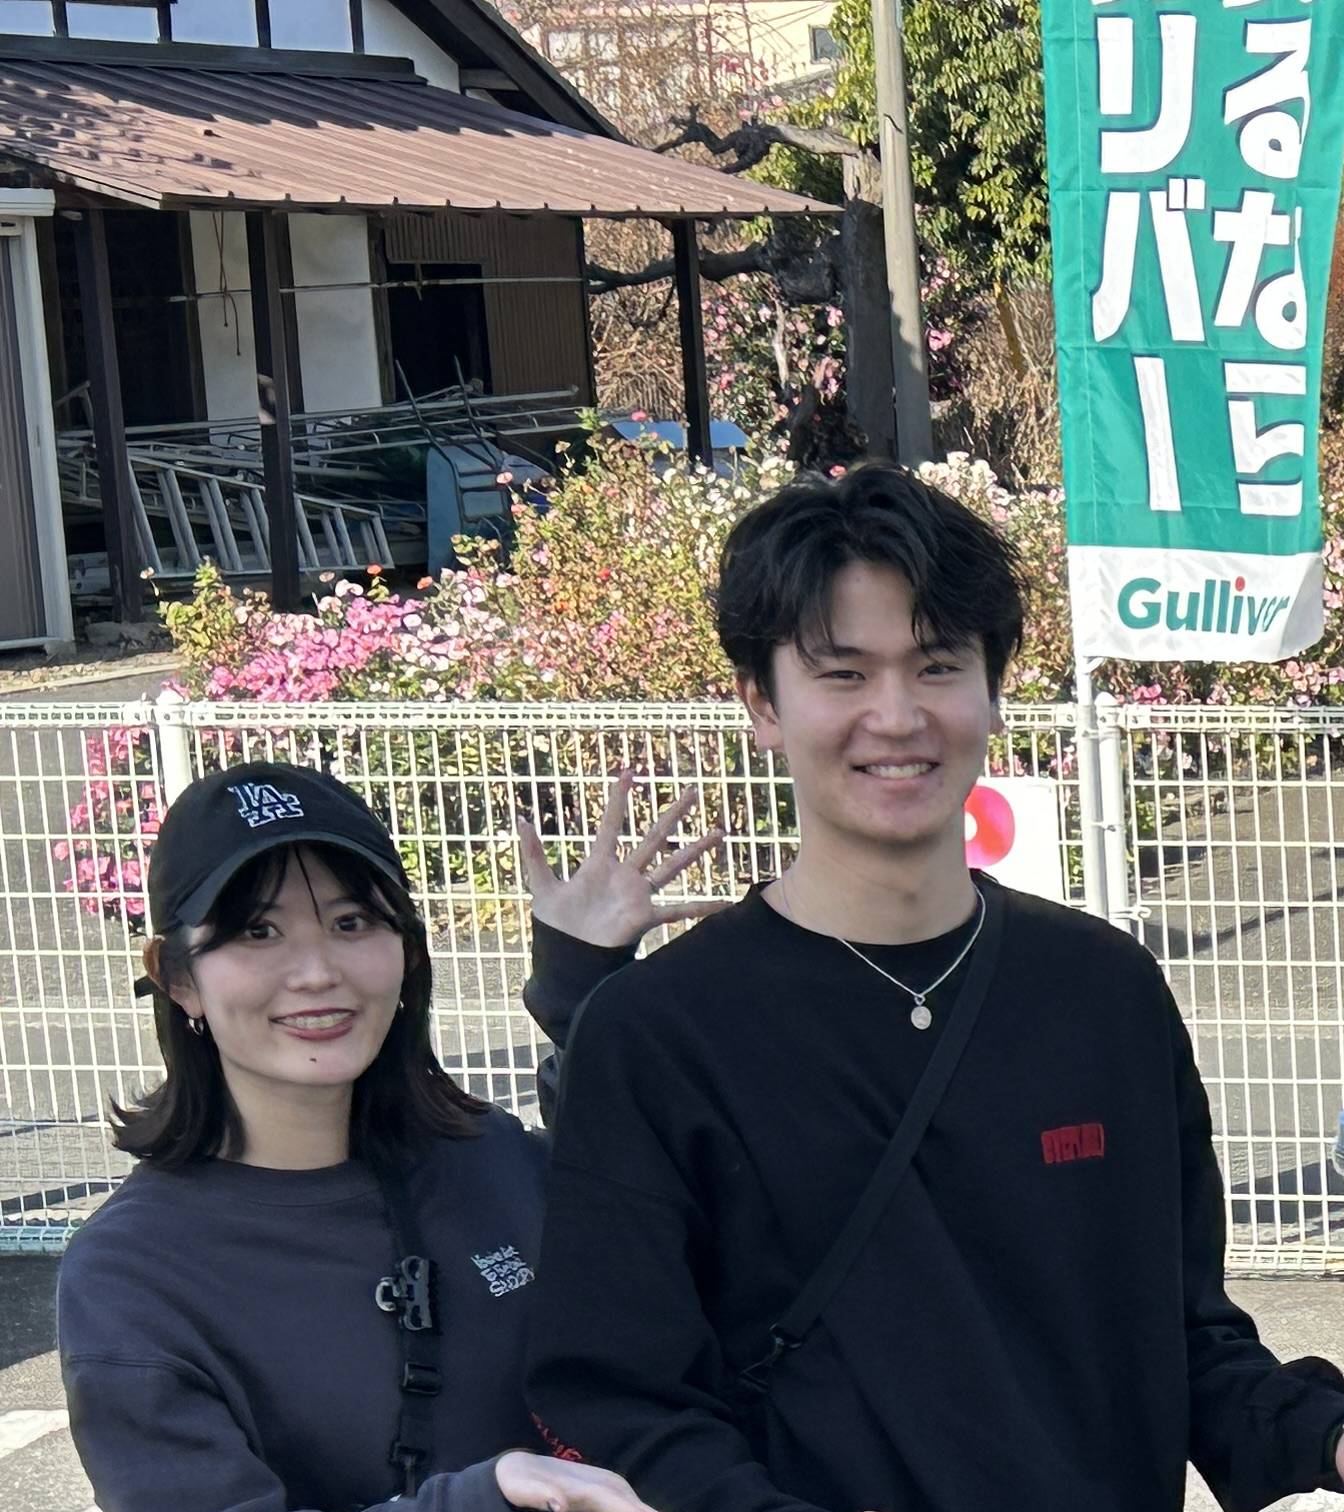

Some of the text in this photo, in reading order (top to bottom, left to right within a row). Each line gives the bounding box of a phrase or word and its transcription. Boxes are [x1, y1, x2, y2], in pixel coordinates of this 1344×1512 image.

[1091, 0, 1206, 513] リバー
[1212, 0, 1313, 516] るなら
[227, 782, 305, 828] LA
